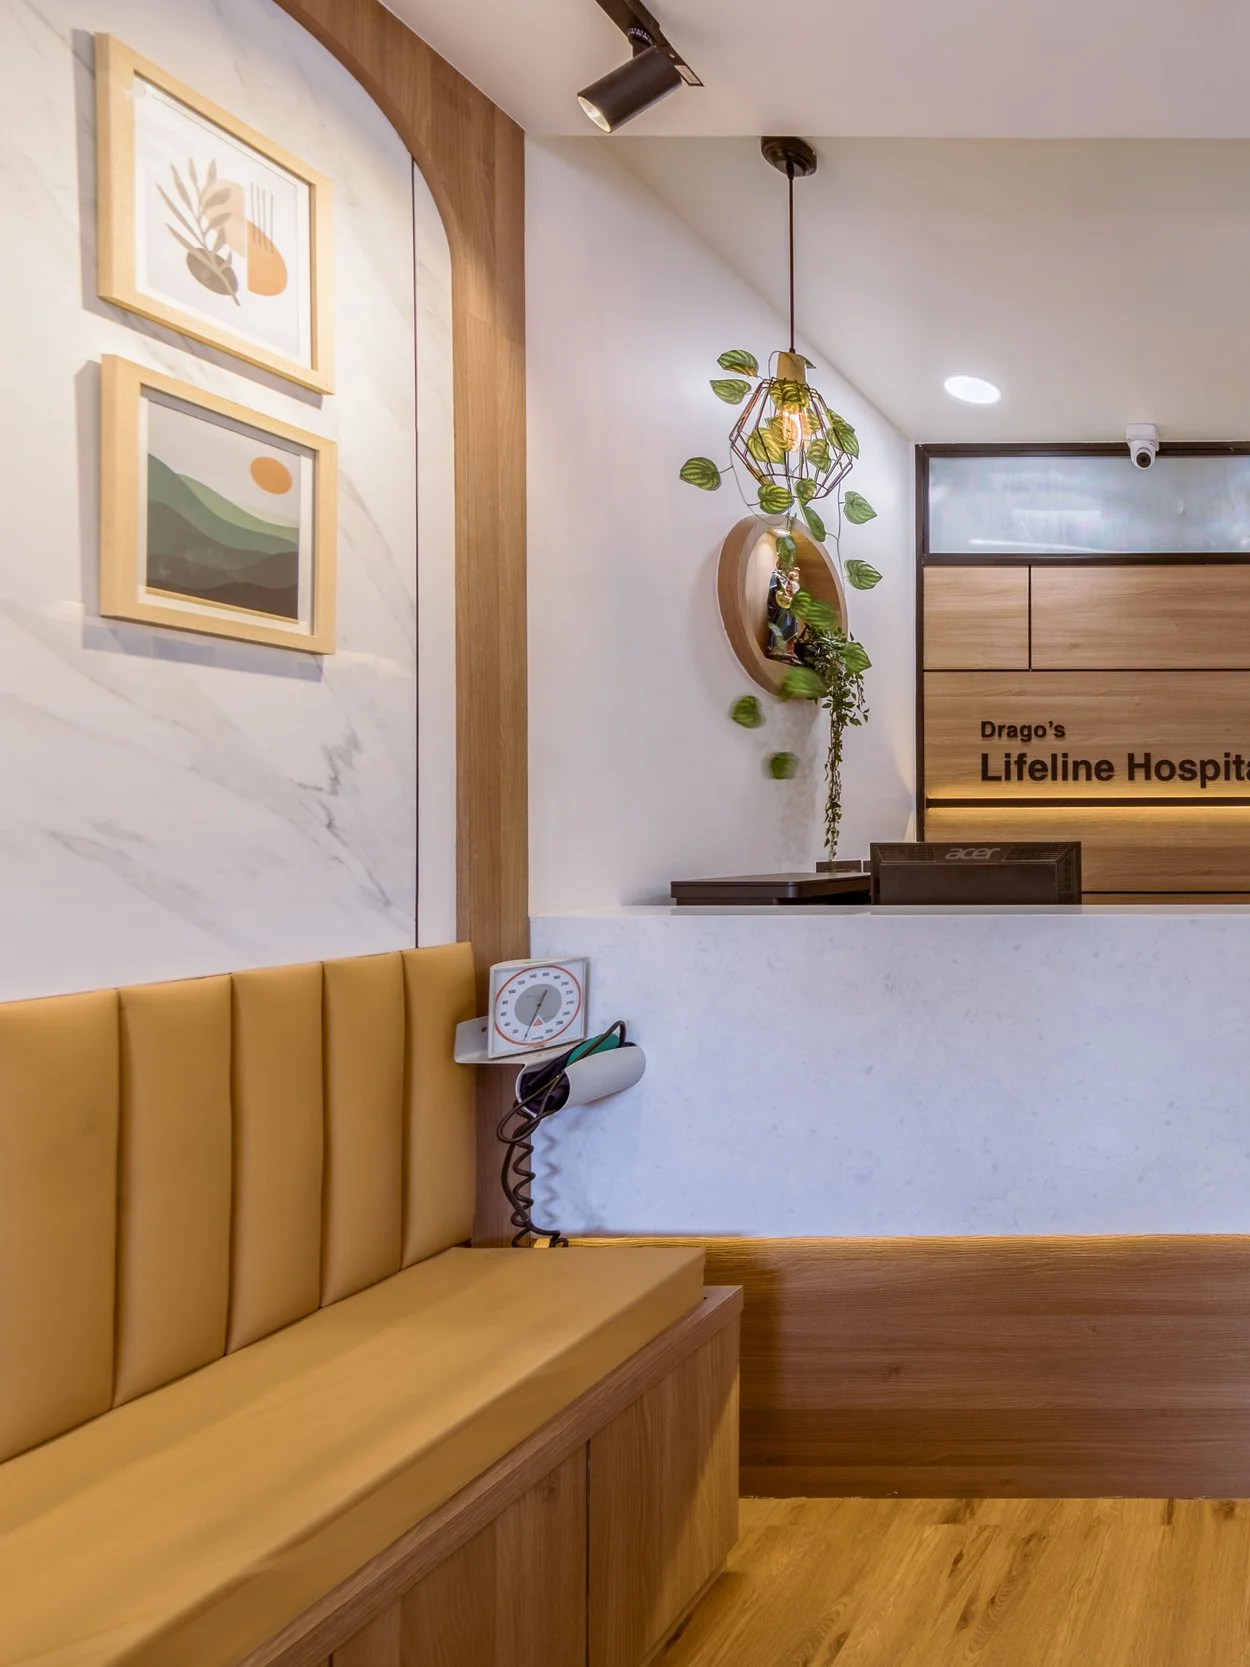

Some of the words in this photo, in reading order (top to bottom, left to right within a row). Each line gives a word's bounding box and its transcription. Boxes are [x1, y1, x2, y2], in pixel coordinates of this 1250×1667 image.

[980, 720, 1066, 742] Drago's
[980, 752, 1115, 782] Lifeline
[945, 847, 1001, 860] acer
